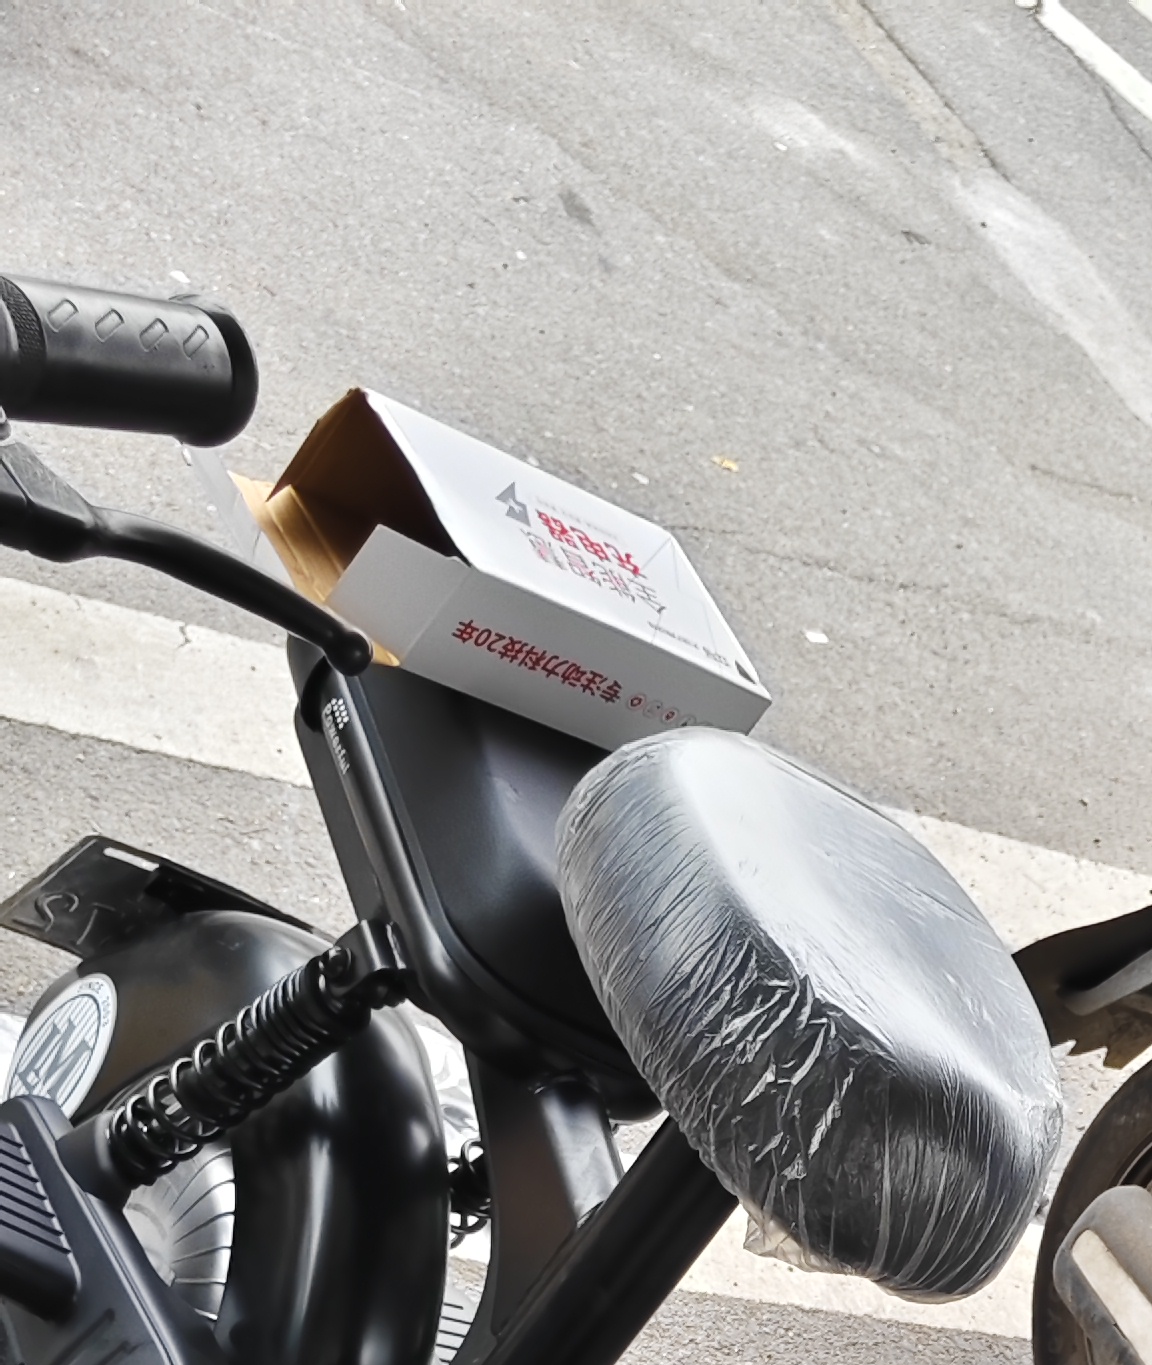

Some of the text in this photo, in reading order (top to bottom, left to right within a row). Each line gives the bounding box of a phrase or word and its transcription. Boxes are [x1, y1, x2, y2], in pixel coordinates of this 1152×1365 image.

[536, 509, 647, 578] 充电器
[452, 619, 623, 703] 专注动力科技20年
